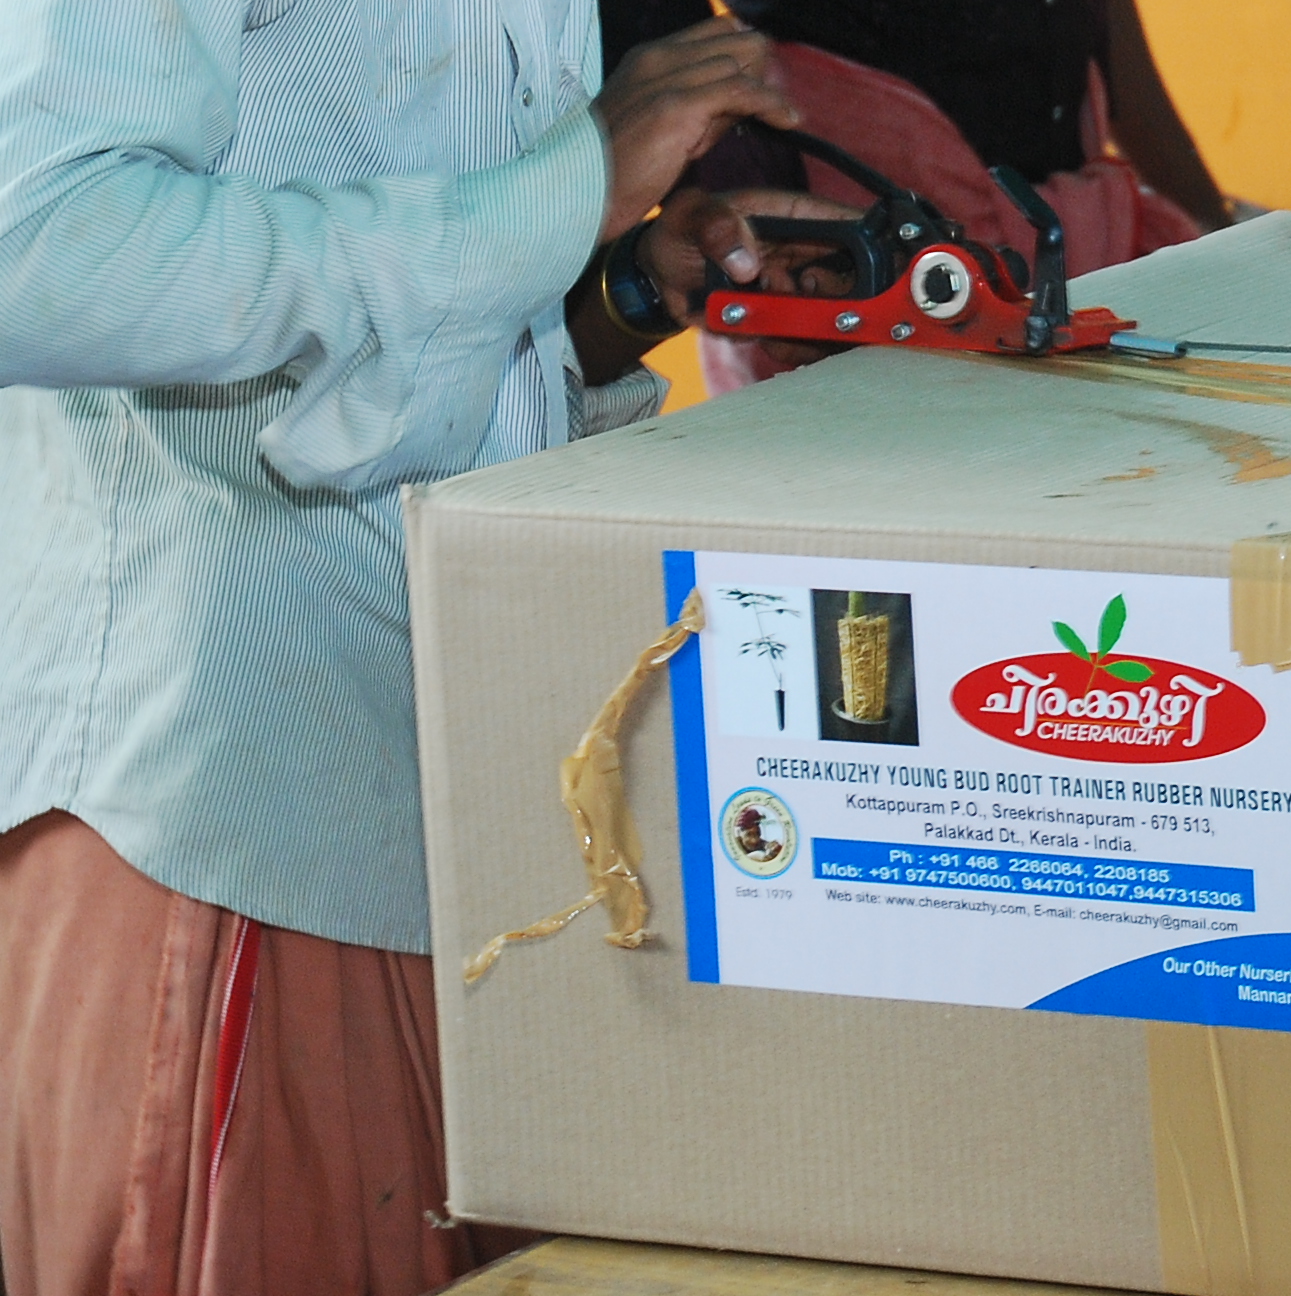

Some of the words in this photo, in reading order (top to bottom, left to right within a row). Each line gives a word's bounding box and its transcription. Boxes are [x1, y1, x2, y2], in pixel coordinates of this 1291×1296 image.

[1037, 721, 1176, 746] CHEERAKUZHY
[757, 757, 880, 785] CHEERAKUZHY
[887, 766, 948, 789] YOUNG
[955, 770, 990, 792] BUD
[997, 773, 1042, 795] ROOT
[1049, 776, 1126, 801] TRAINER
[1133, 782, 1203, 806] RUBBER
[846, 794, 945, 816] Kottappuram
[992, 804, 1135, 829] Sreekrishnapuram
[1151, 815, 1178, 832] 679
[1183, 818, 1215, 836] 513,
[924, 823, 993, 842] Palakkad
[1030, 831, 1079, 848] Kerala
[1094, 835, 1137, 853] India.
[821, 862, 863, 878] Mob:
[869, 867, 900, 881] +91
[890, 849, 913, 864] Ph
[929, 853, 959, 868] +91
[1094, 864, 1170, 883] 2208185
[766, 888, 793, 900] 1979
[826, 889, 852, 902] Web
[856, 892, 881, 904] site:
[885, 894, 1031, 917] www.cheerakuzhy.com,
[1034, 904, 1076, 920] E-mail:
[1079, 909, 1238, 932] cheerakuzhy@gmail.com
[1163, 957, 1191, 974] Our
[1193, 960, 1237, 978] Other
